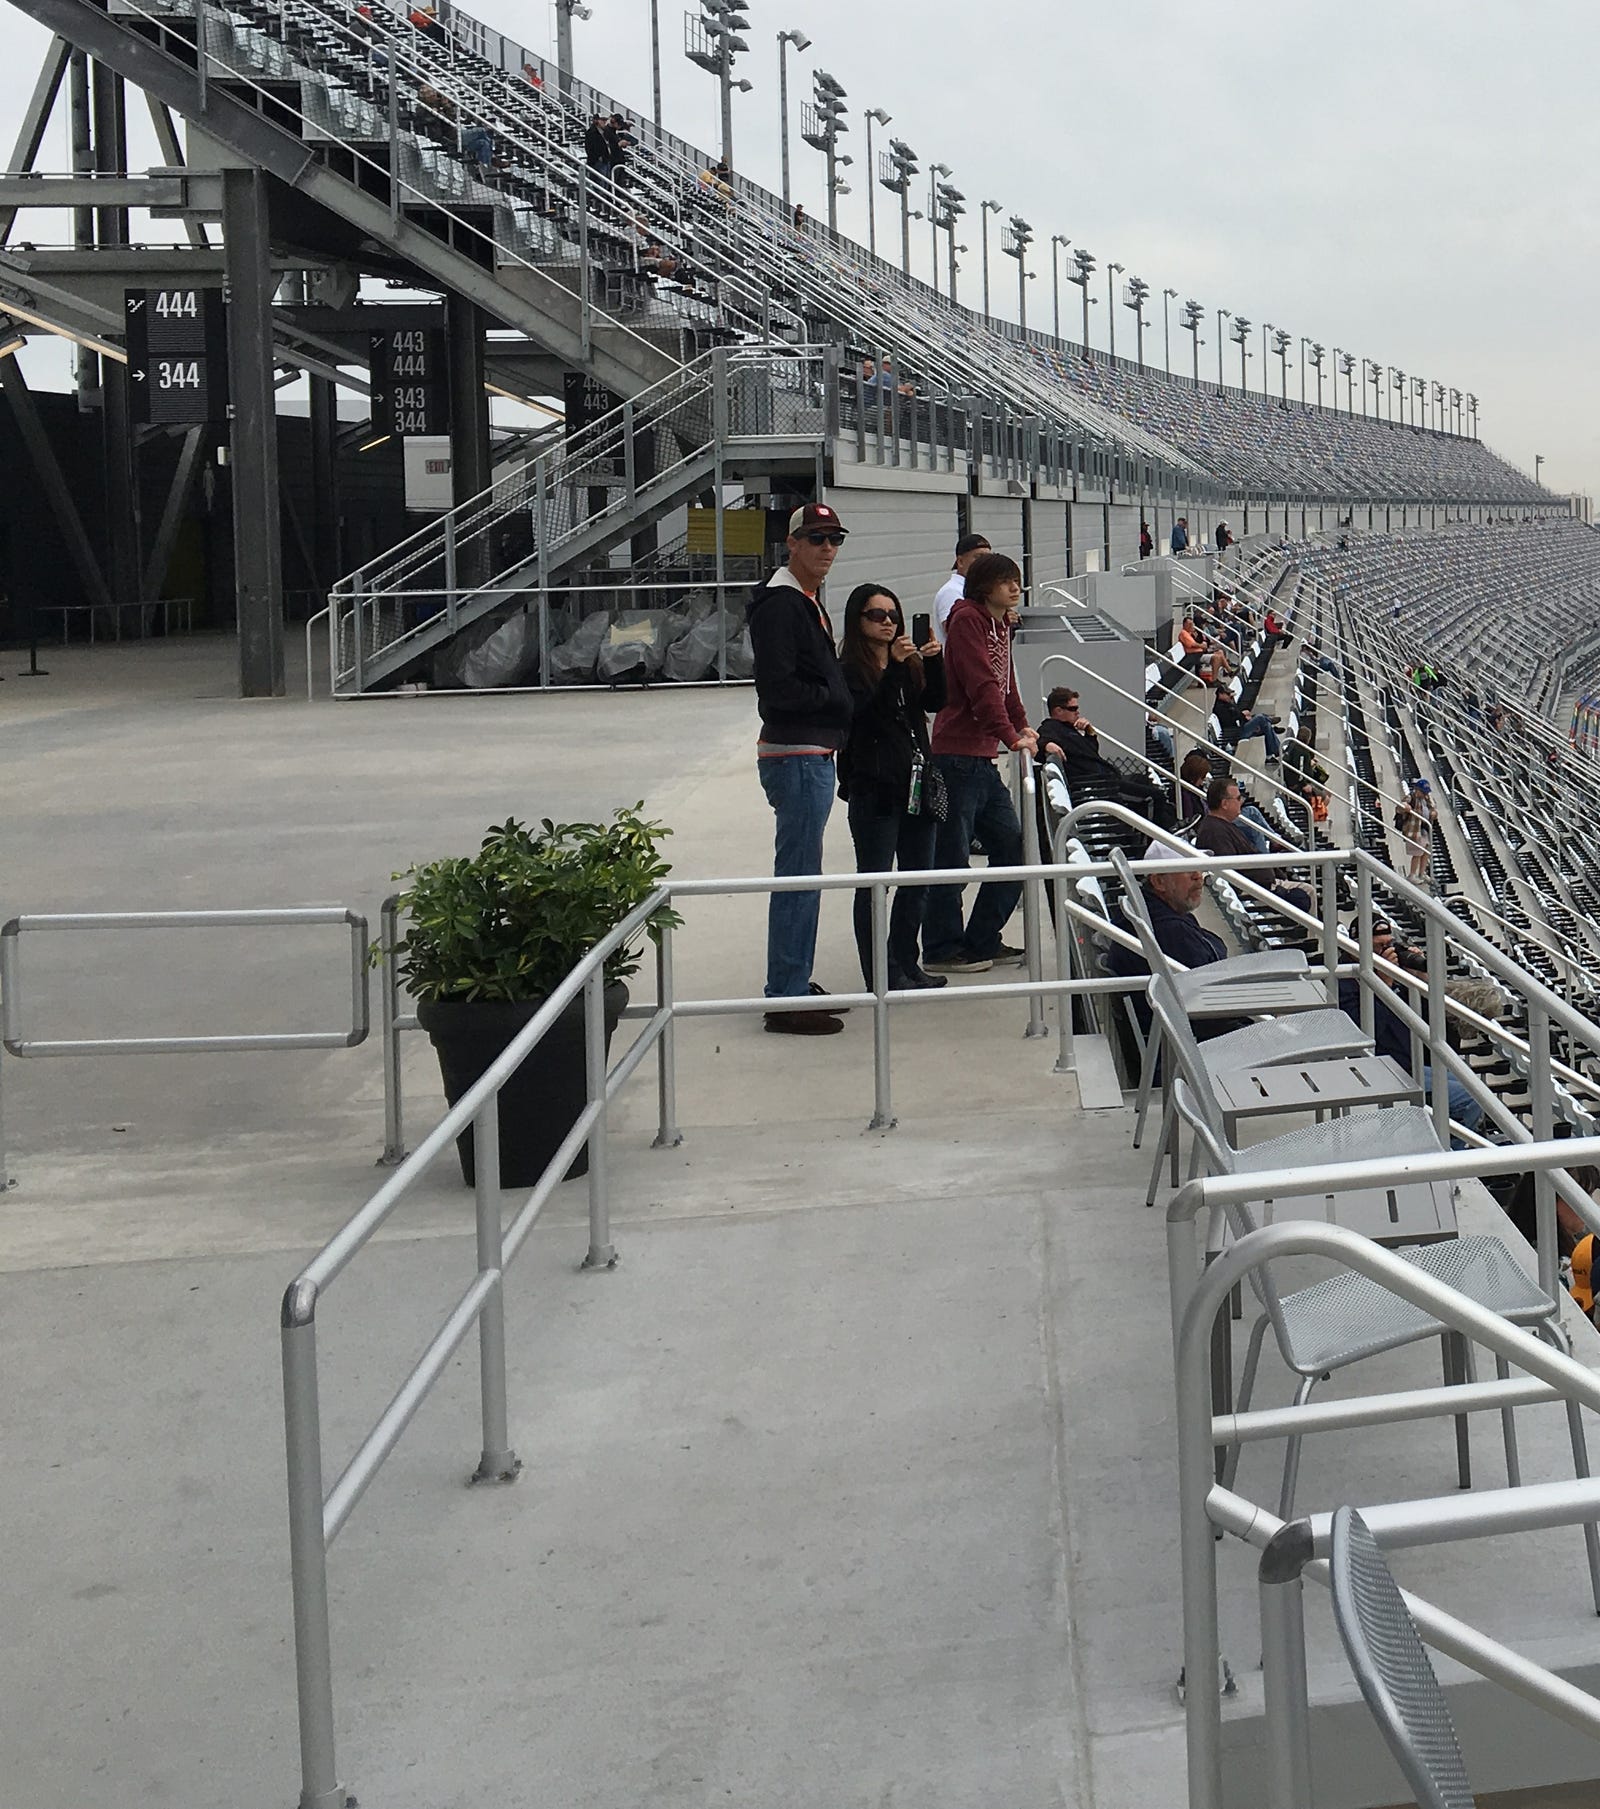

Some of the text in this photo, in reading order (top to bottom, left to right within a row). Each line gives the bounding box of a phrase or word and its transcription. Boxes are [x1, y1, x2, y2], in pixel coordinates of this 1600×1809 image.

[155, 291, 197, 318] 444
[392, 331, 424, 352] 443
[158, 362, 200, 389] 344
[393, 355, 425, 376] 444
[394, 387, 425, 409] 343
[583, 393, 609, 410] 443
[394, 411, 426, 432] 344
